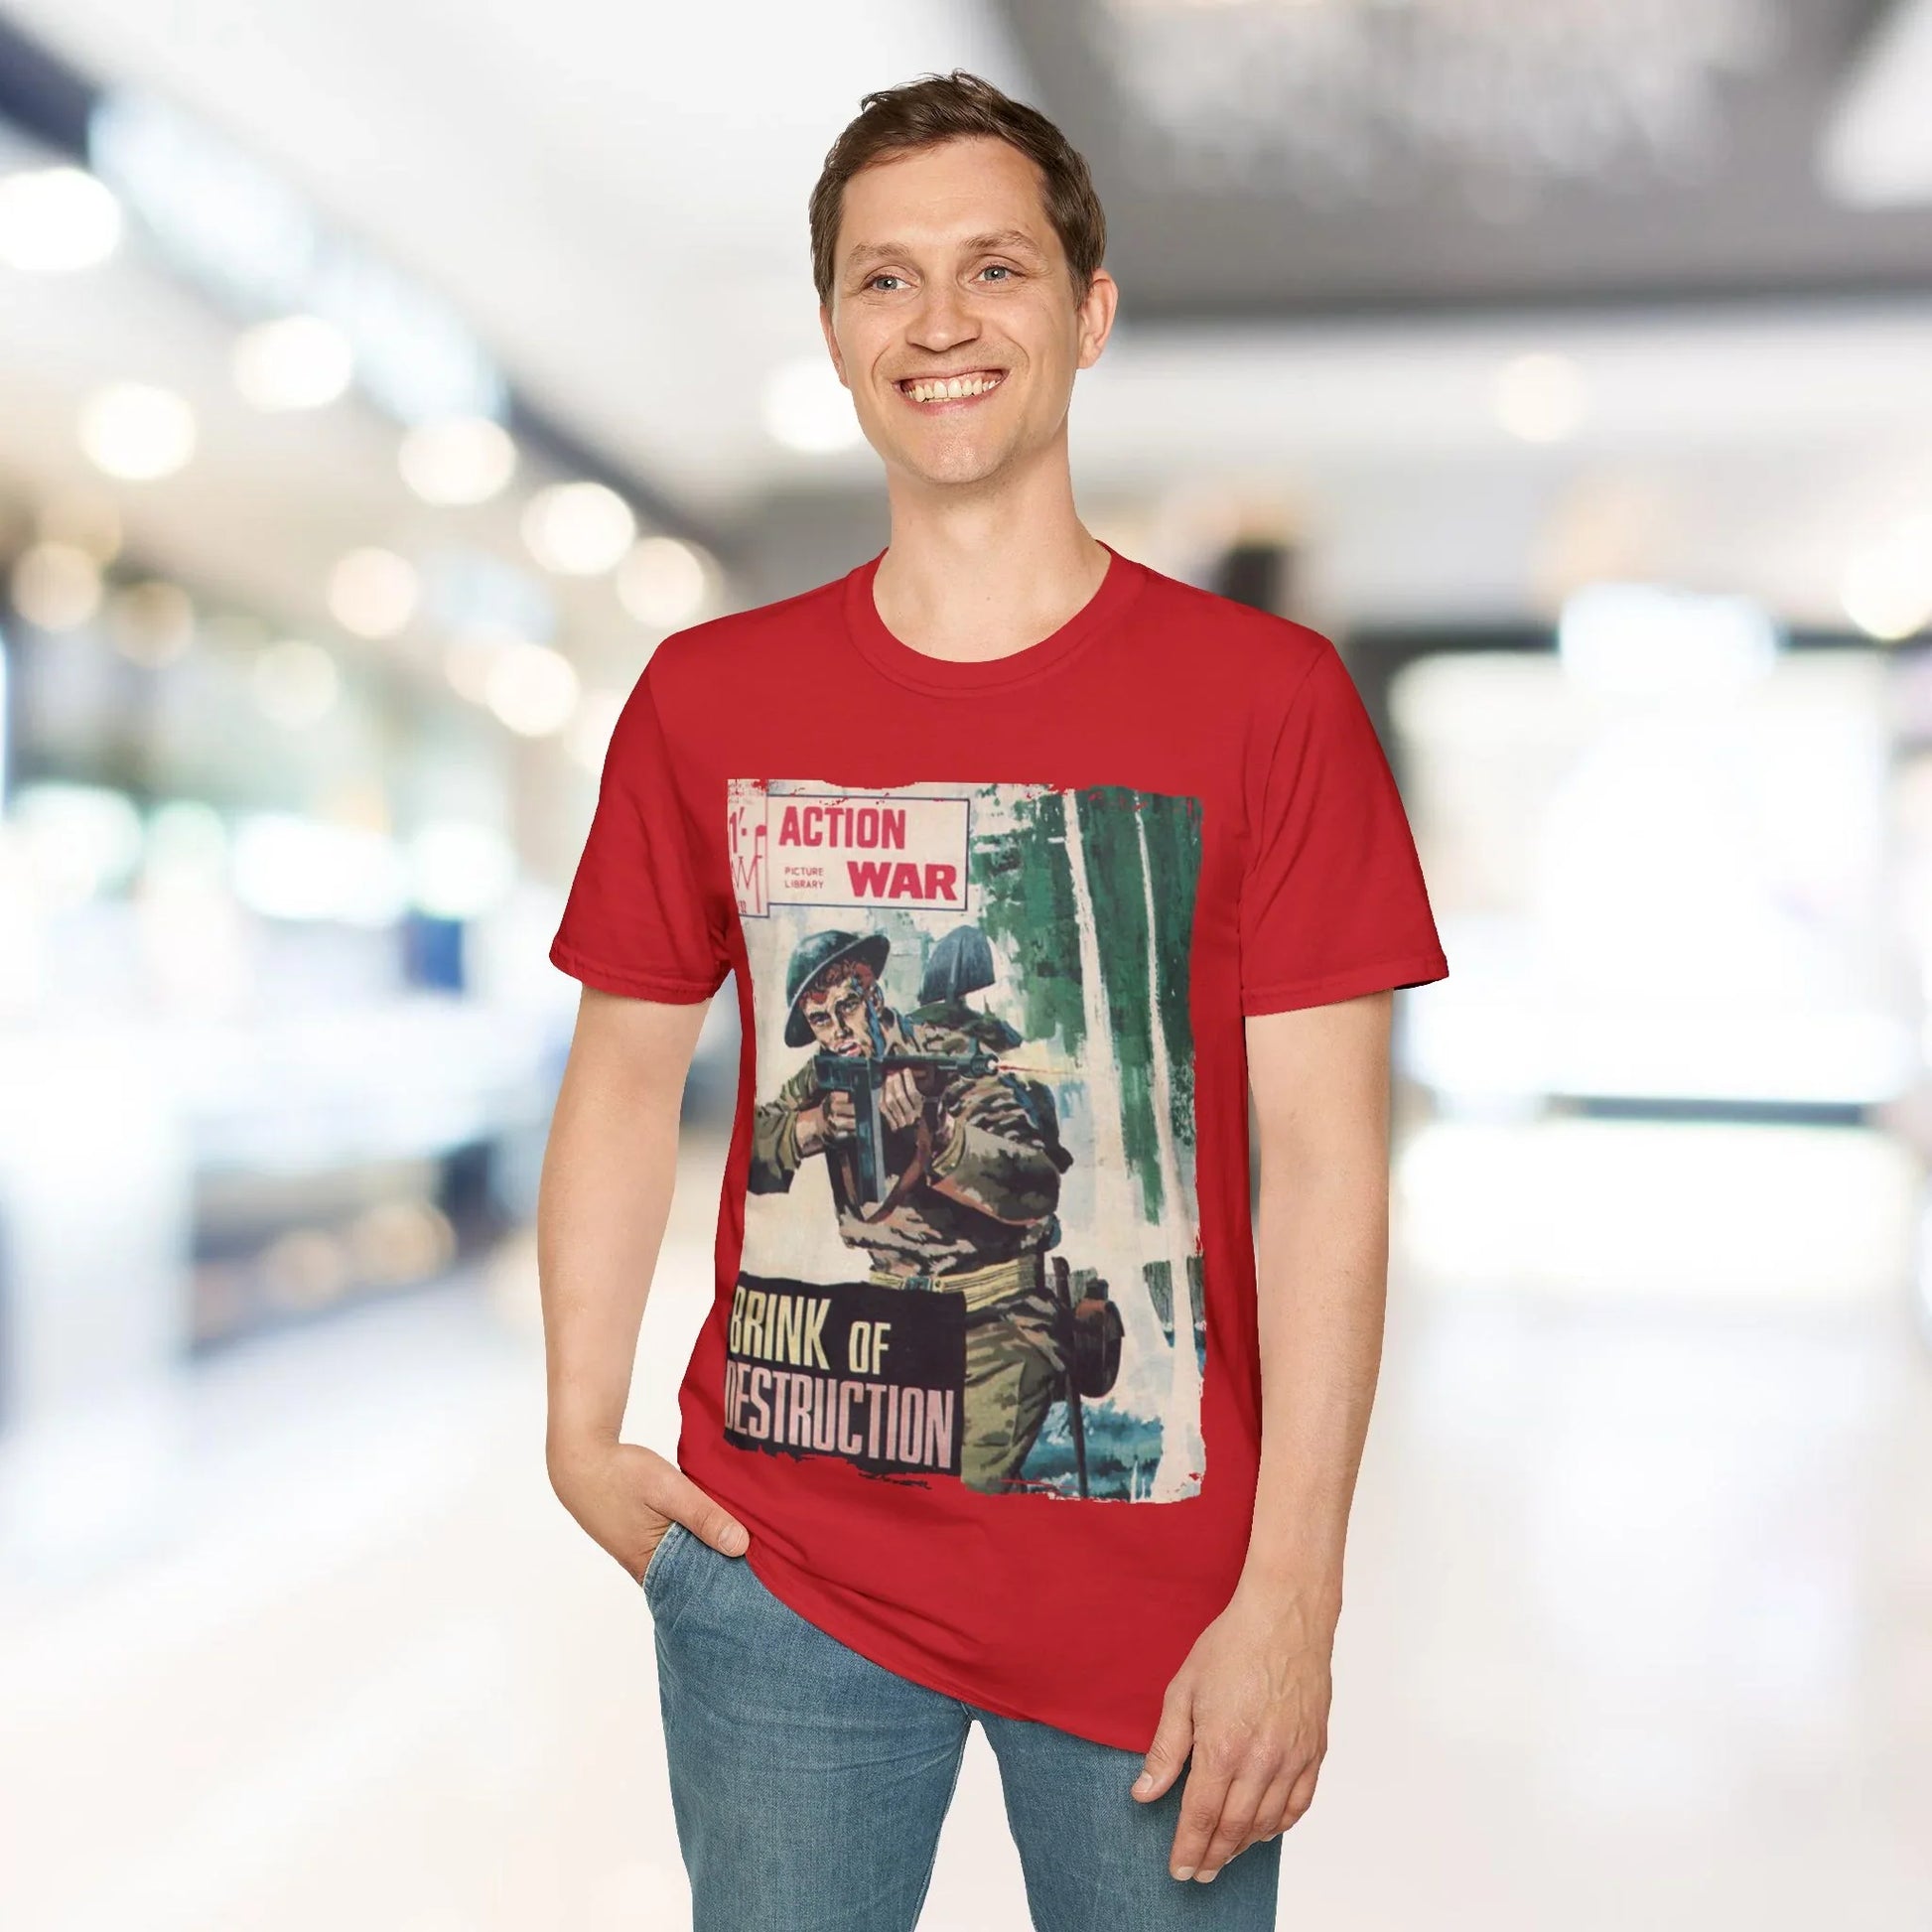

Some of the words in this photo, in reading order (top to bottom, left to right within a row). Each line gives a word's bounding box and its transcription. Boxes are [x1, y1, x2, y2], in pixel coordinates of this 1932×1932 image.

[778, 806, 906, 850] ACTION
[784, 866, 824, 877] PICTURE
[784, 879, 824, 890] LIBRARY
[847, 861, 958, 901] WAR
[730, 1286, 832, 1371] BRINK
[848, 1320, 893, 1375] OF
[725, 1359, 955, 1469] DESTRUCTION
